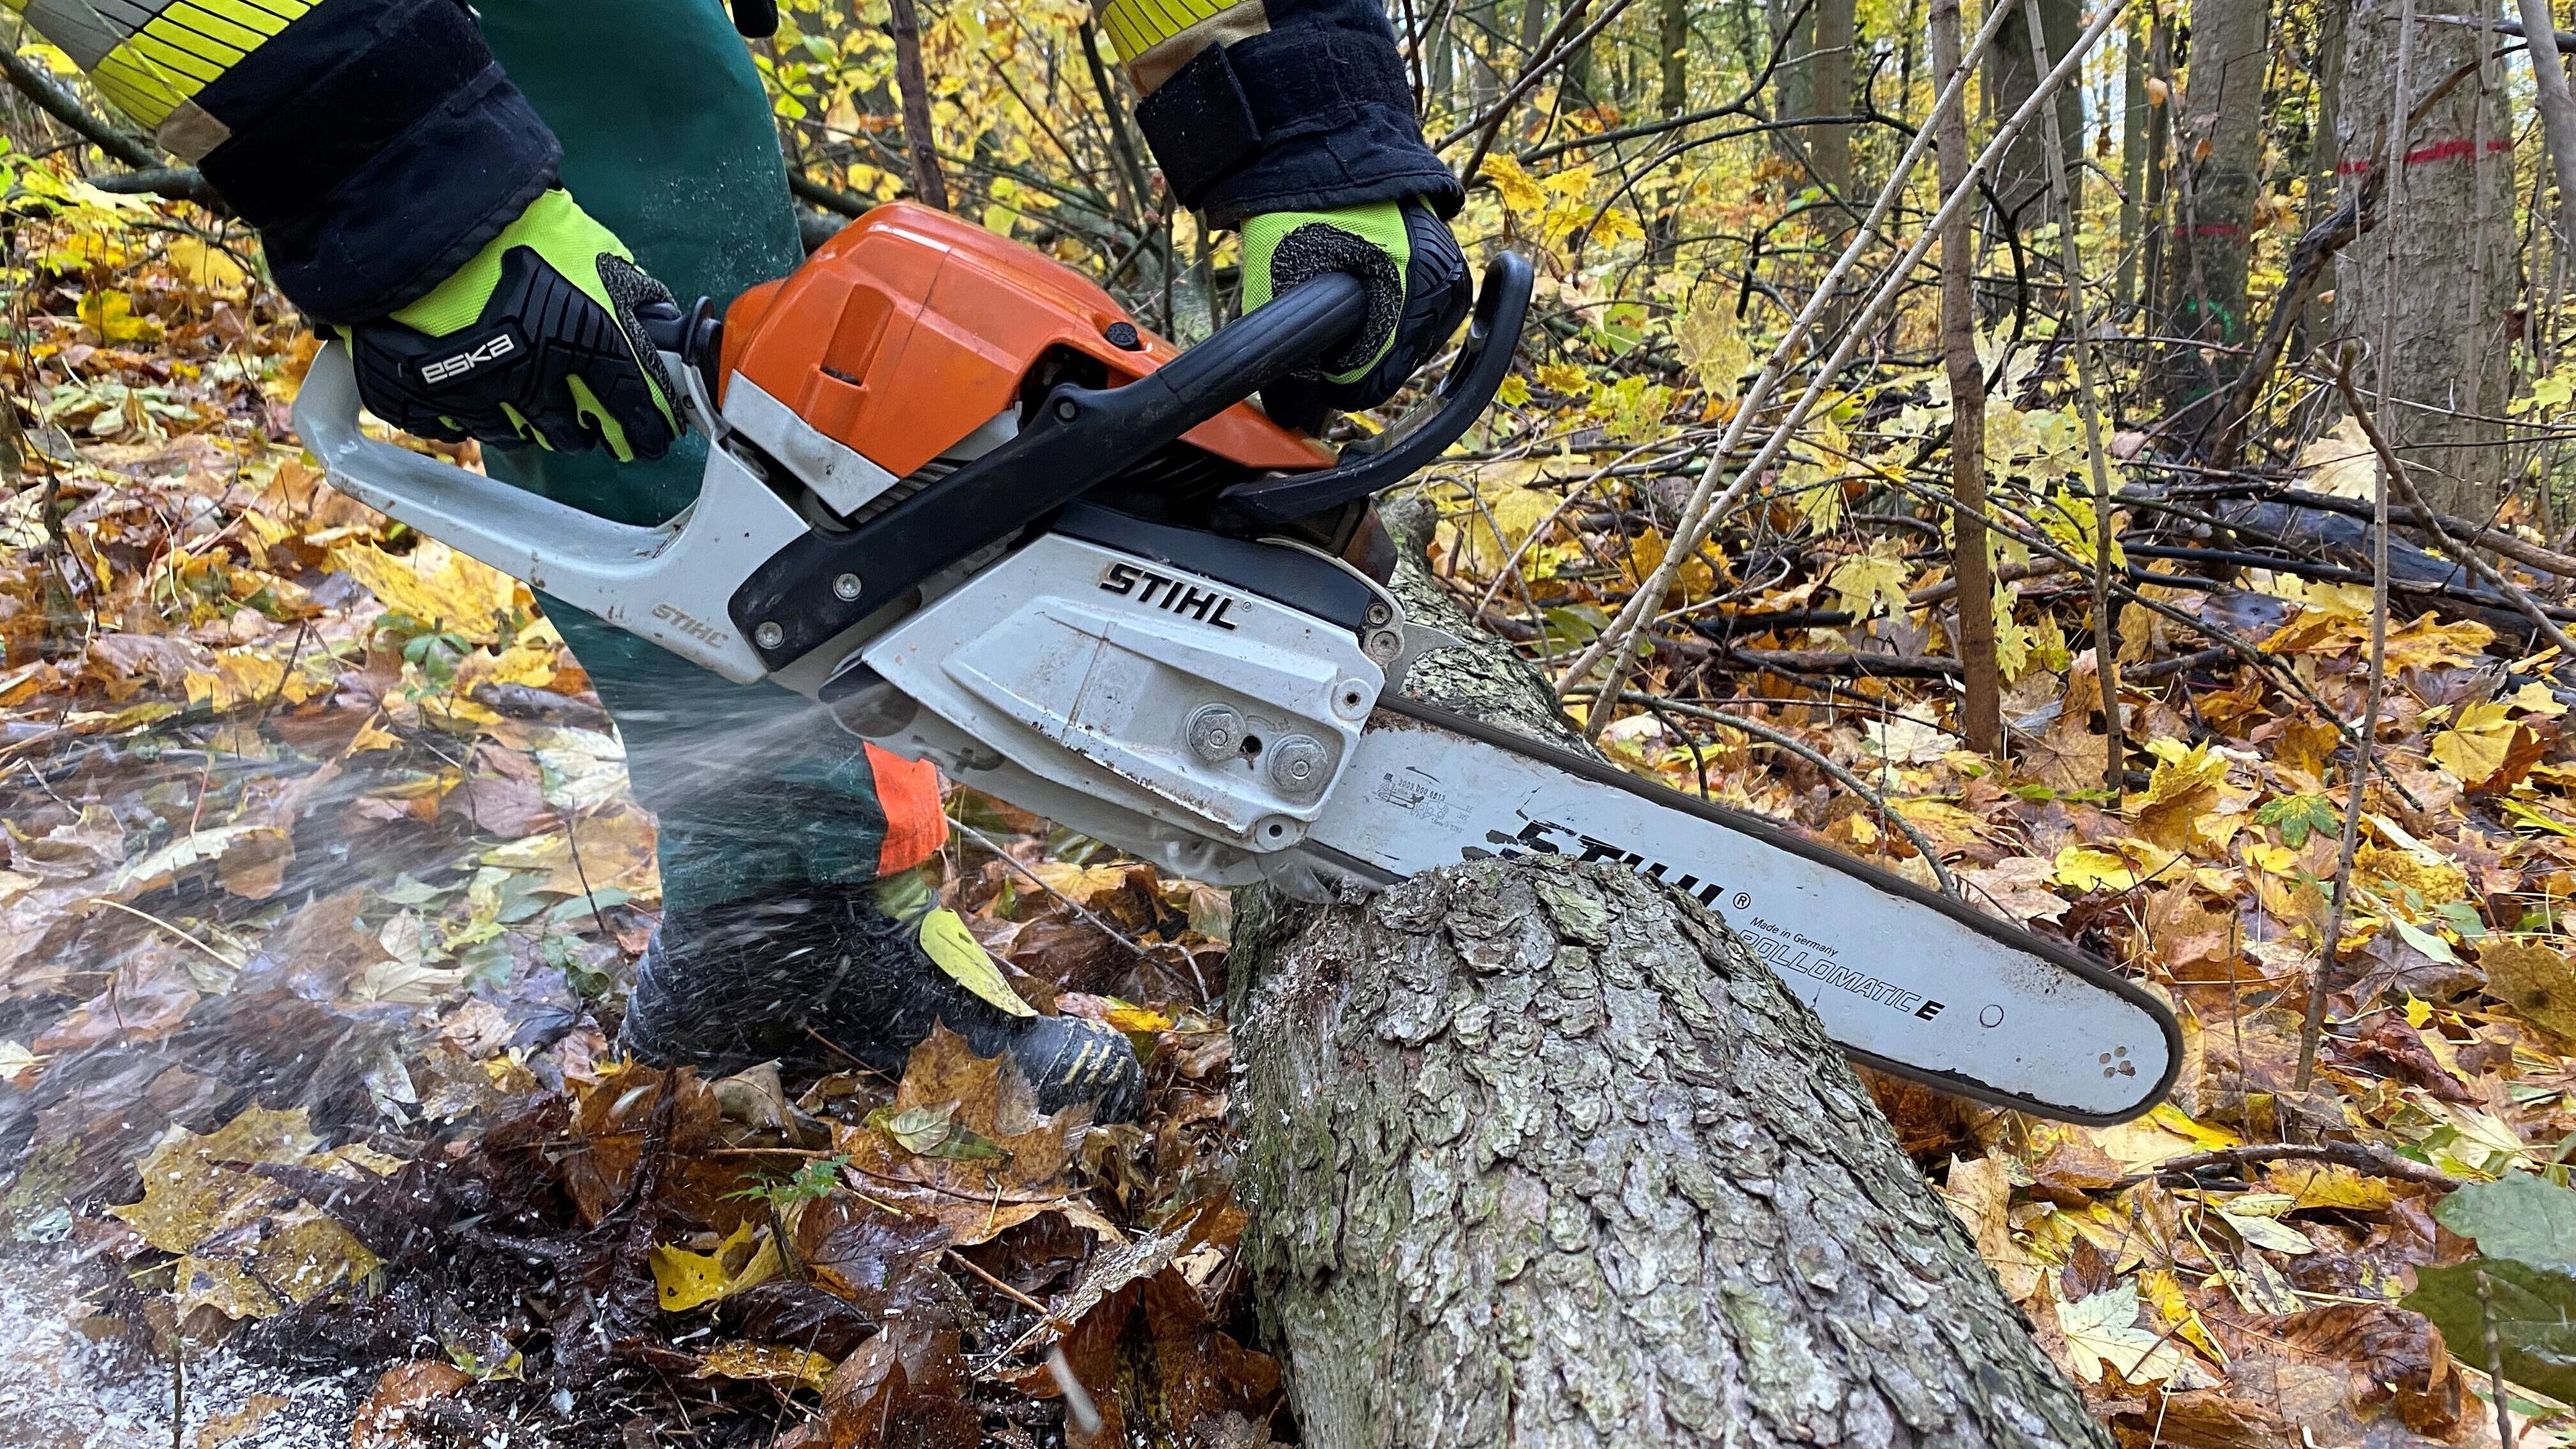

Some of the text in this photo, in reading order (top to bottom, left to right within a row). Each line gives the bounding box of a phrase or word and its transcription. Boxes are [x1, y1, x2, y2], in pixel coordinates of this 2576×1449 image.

[421, 334, 515, 384] eska
[1099, 563, 1238, 631] STIHL
[651, 604, 722, 649] STIHL
[1750, 917, 1839, 957] Made in Germany
[1914, 999, 1945, 1021] E
